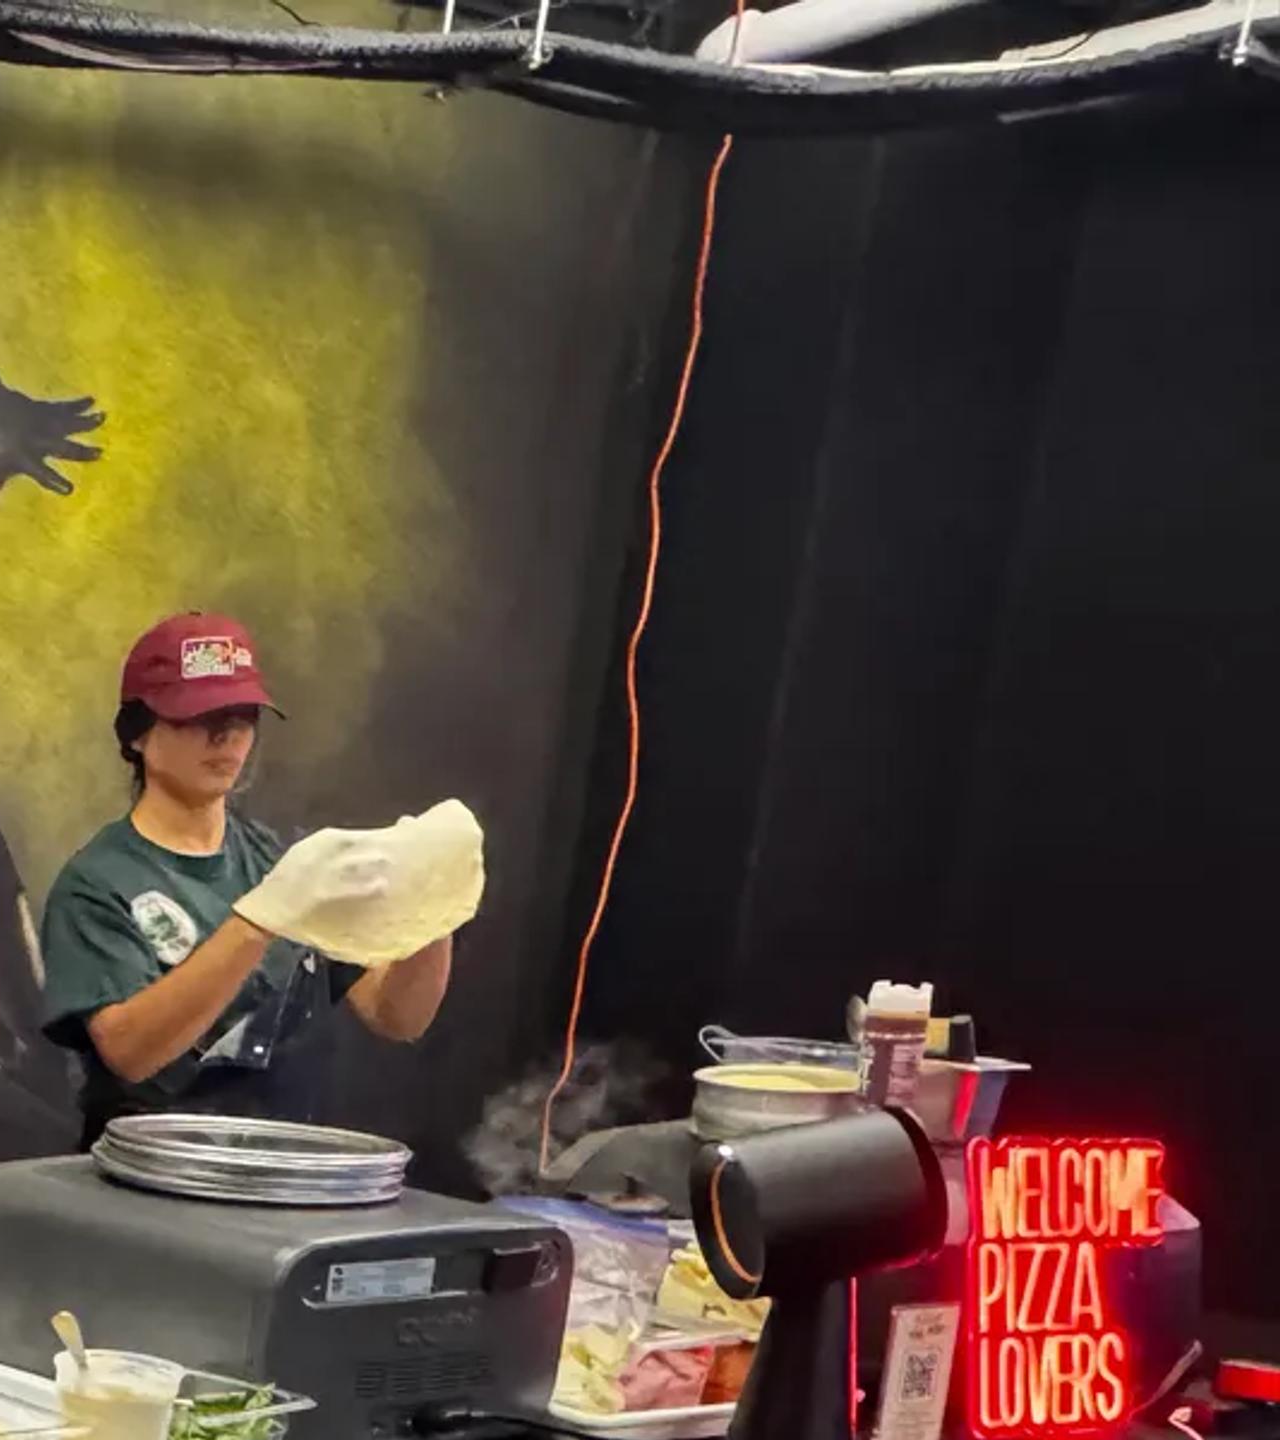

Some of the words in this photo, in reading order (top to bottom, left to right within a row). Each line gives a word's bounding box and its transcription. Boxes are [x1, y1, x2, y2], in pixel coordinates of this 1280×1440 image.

[978, 1145, 1164, 1239] WELCOME
[977, 1240, 1104, 1333] PIZZA
[977, 1330, 1125, 1429] LOVERS
